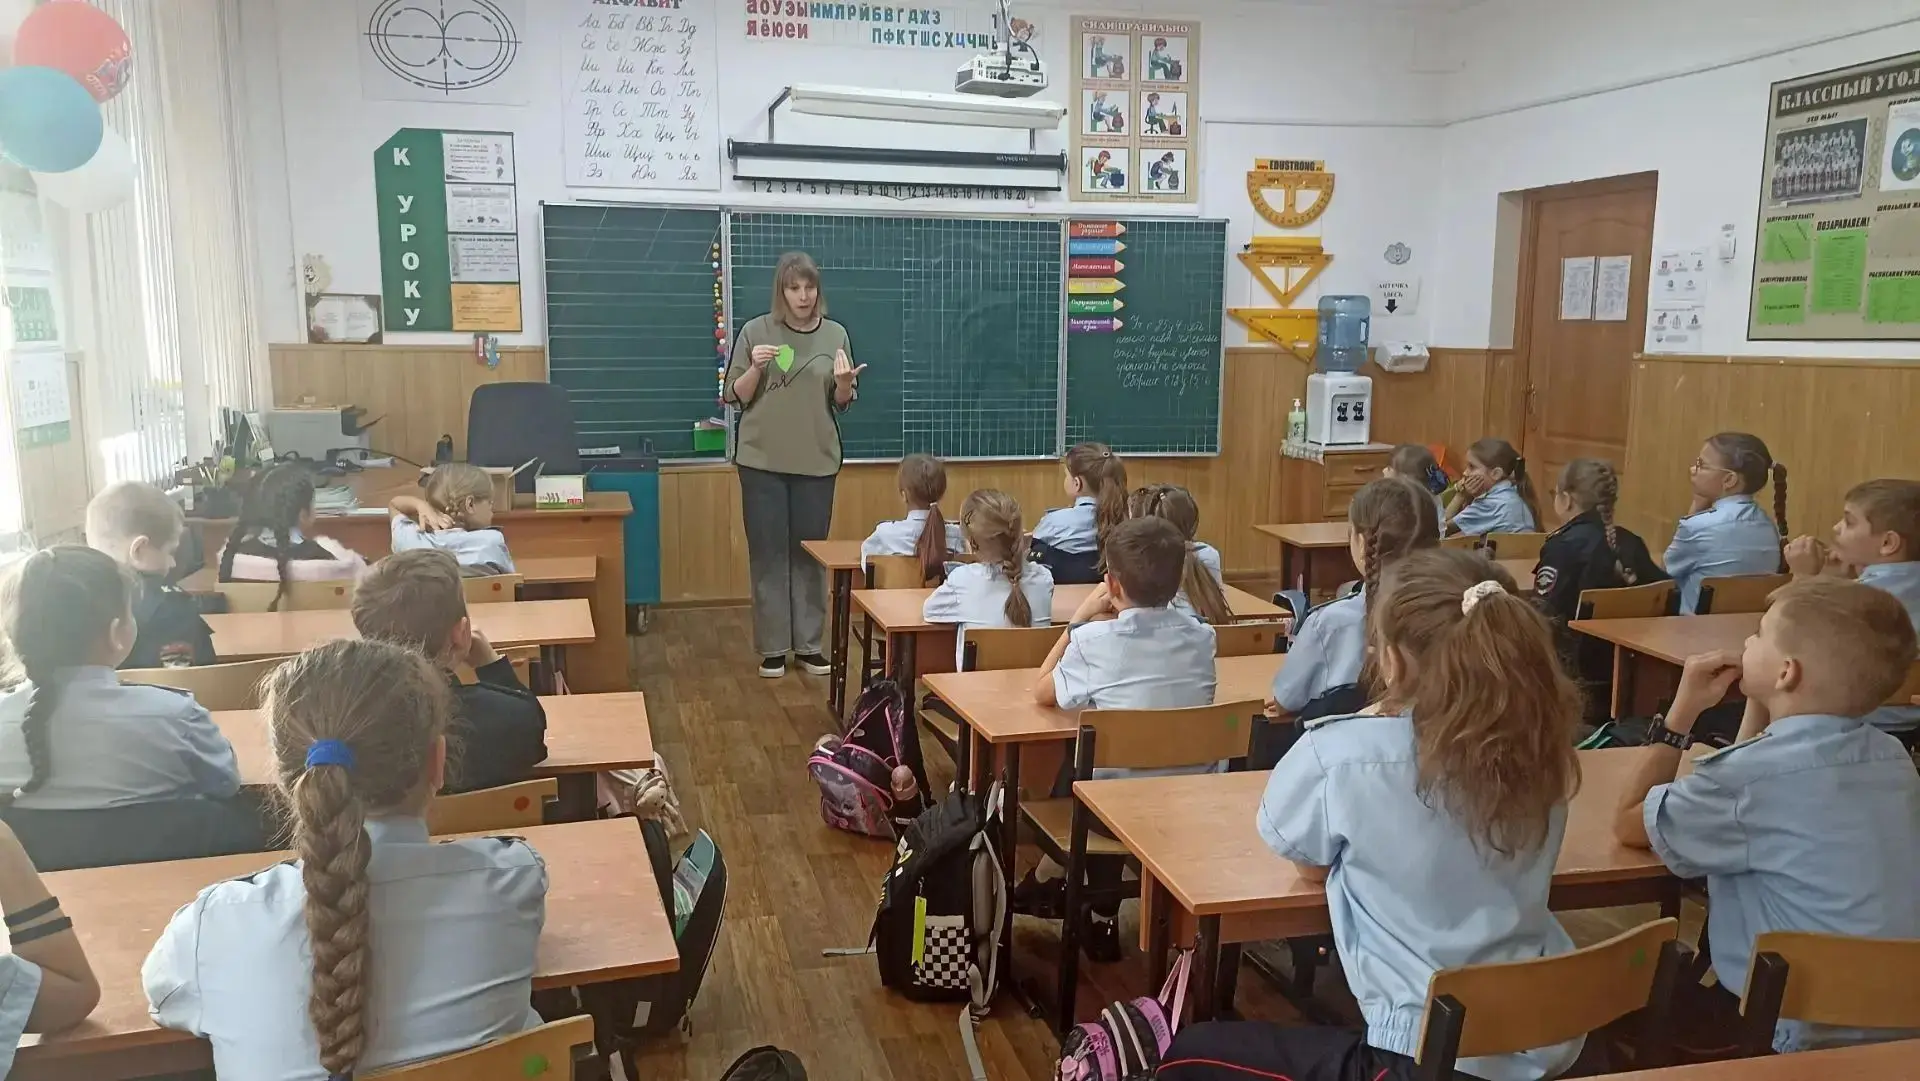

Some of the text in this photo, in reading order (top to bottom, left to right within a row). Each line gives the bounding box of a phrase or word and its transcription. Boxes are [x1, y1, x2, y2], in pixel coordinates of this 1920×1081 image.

[1118, 22, 1189, 33] ПРАВИЛЬНО
[1780, 76, 1872, 110] КЛАССНЫЙ
[393, 148, 411, 166] К
[1270, 160, 1315, 171] EDUSTRONG
[752, 181, 1026, 200] 1 2 3 4 5 6 7 8 9 10 11 12 13 14 15 16 17 18 19 20
[1816, 217, 1870, 231] ПОЗДРАВЛЯЕМ!
